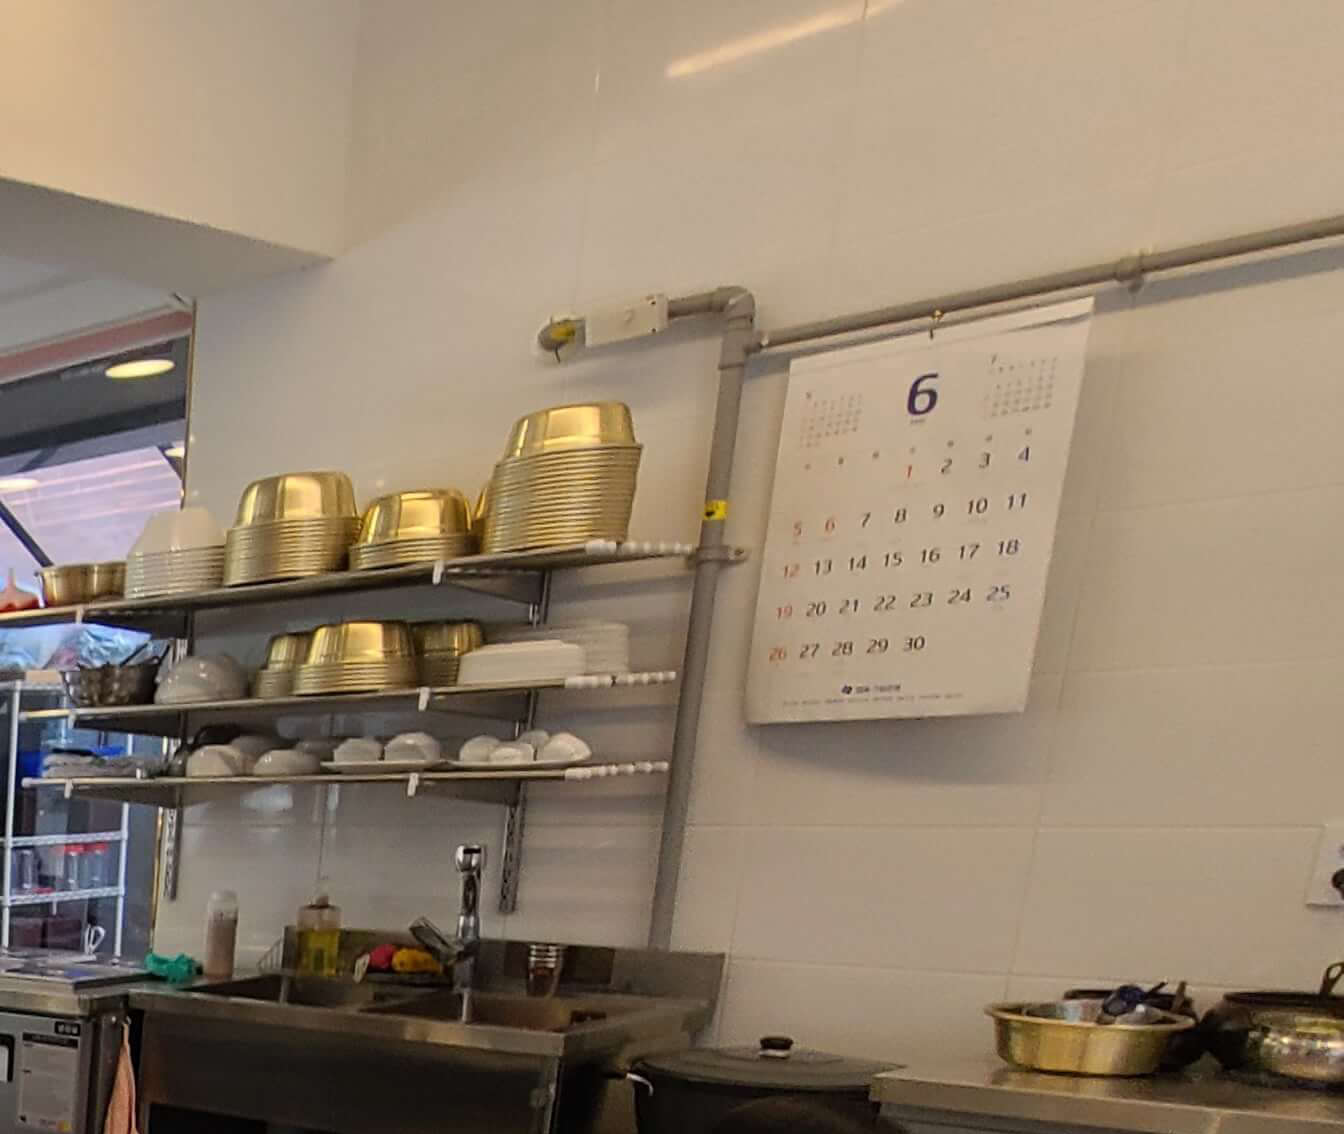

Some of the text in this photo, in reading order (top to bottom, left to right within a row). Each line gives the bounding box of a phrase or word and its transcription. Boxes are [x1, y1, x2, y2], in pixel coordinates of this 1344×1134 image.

[906, 373, 940, 416] 6
[906, 446, 1031, 480] 1 2 3 4
[793, 493, 1028, 536] 5 6 7 8 9 10 11
[783, 539, 1020, 579] 12 13 14 15 16 17 18
[776, 584, 1011, 620] 19 20 21 22 23 24 25
[768, 635, 926, 662] 26 27 28 29 30
